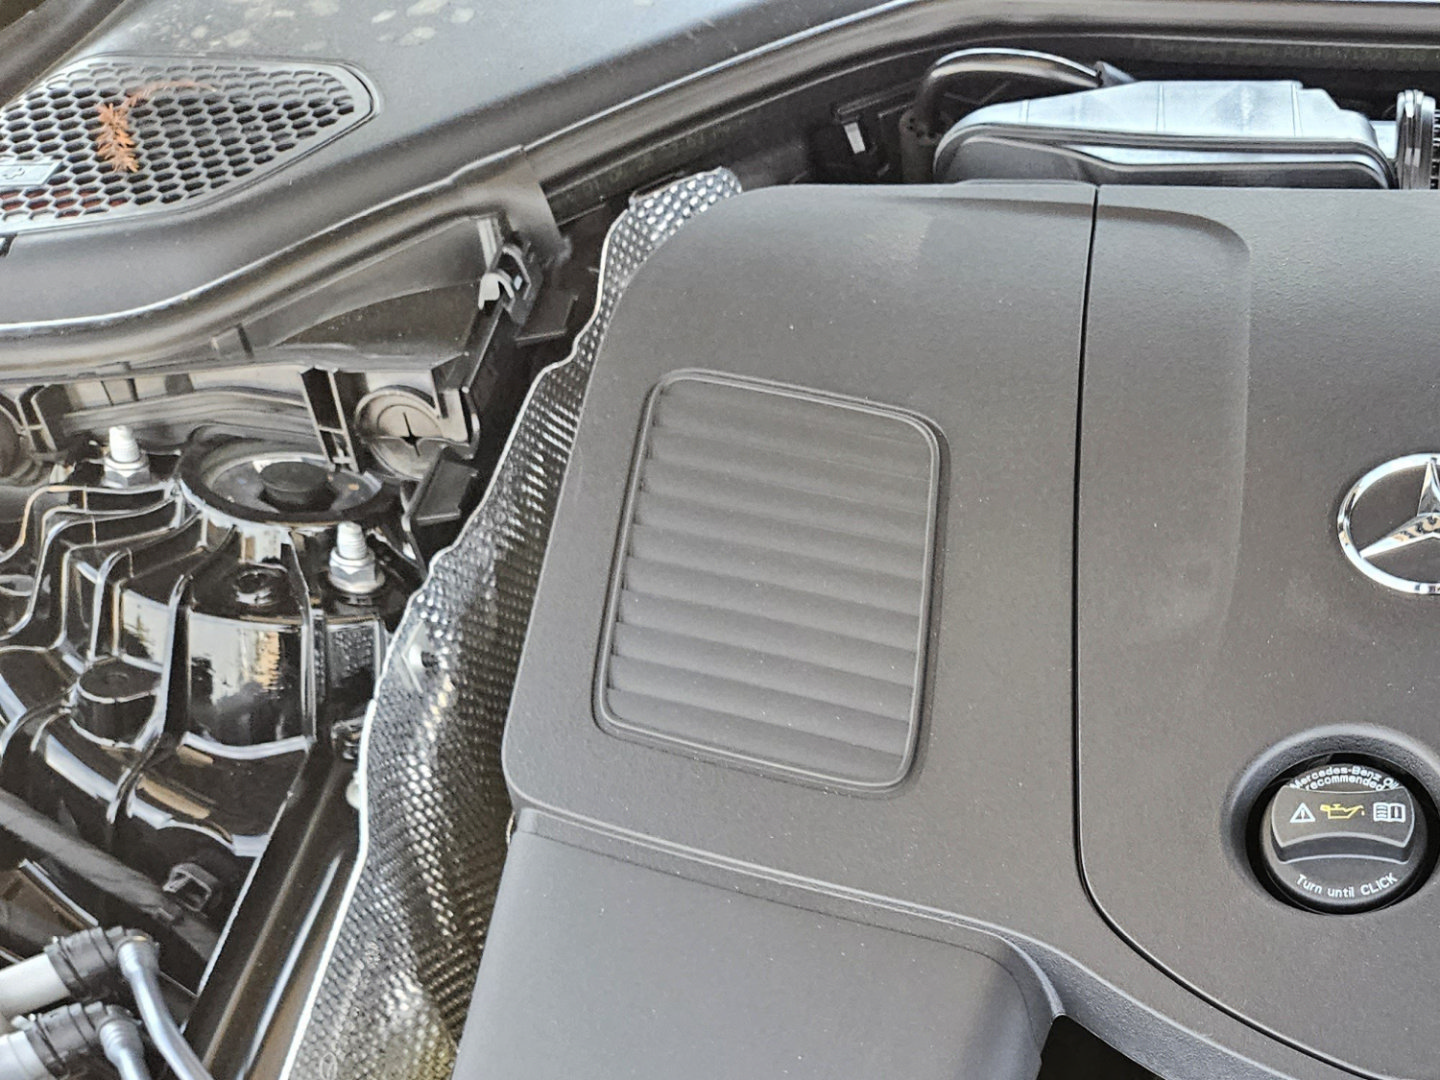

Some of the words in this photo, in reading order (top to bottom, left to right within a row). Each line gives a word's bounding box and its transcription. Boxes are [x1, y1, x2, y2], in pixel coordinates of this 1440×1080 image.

[1290, 766, 1382, 789] Mercedes-Benz
[1383, 777, 1400, 790] Oil
[1305, 775, 1385, 791] recommended
[1296, 874, 1322, 894] Turn
[1327, 886, 1355, 898] until
[1360, 873, 1397, 895] CLICK
